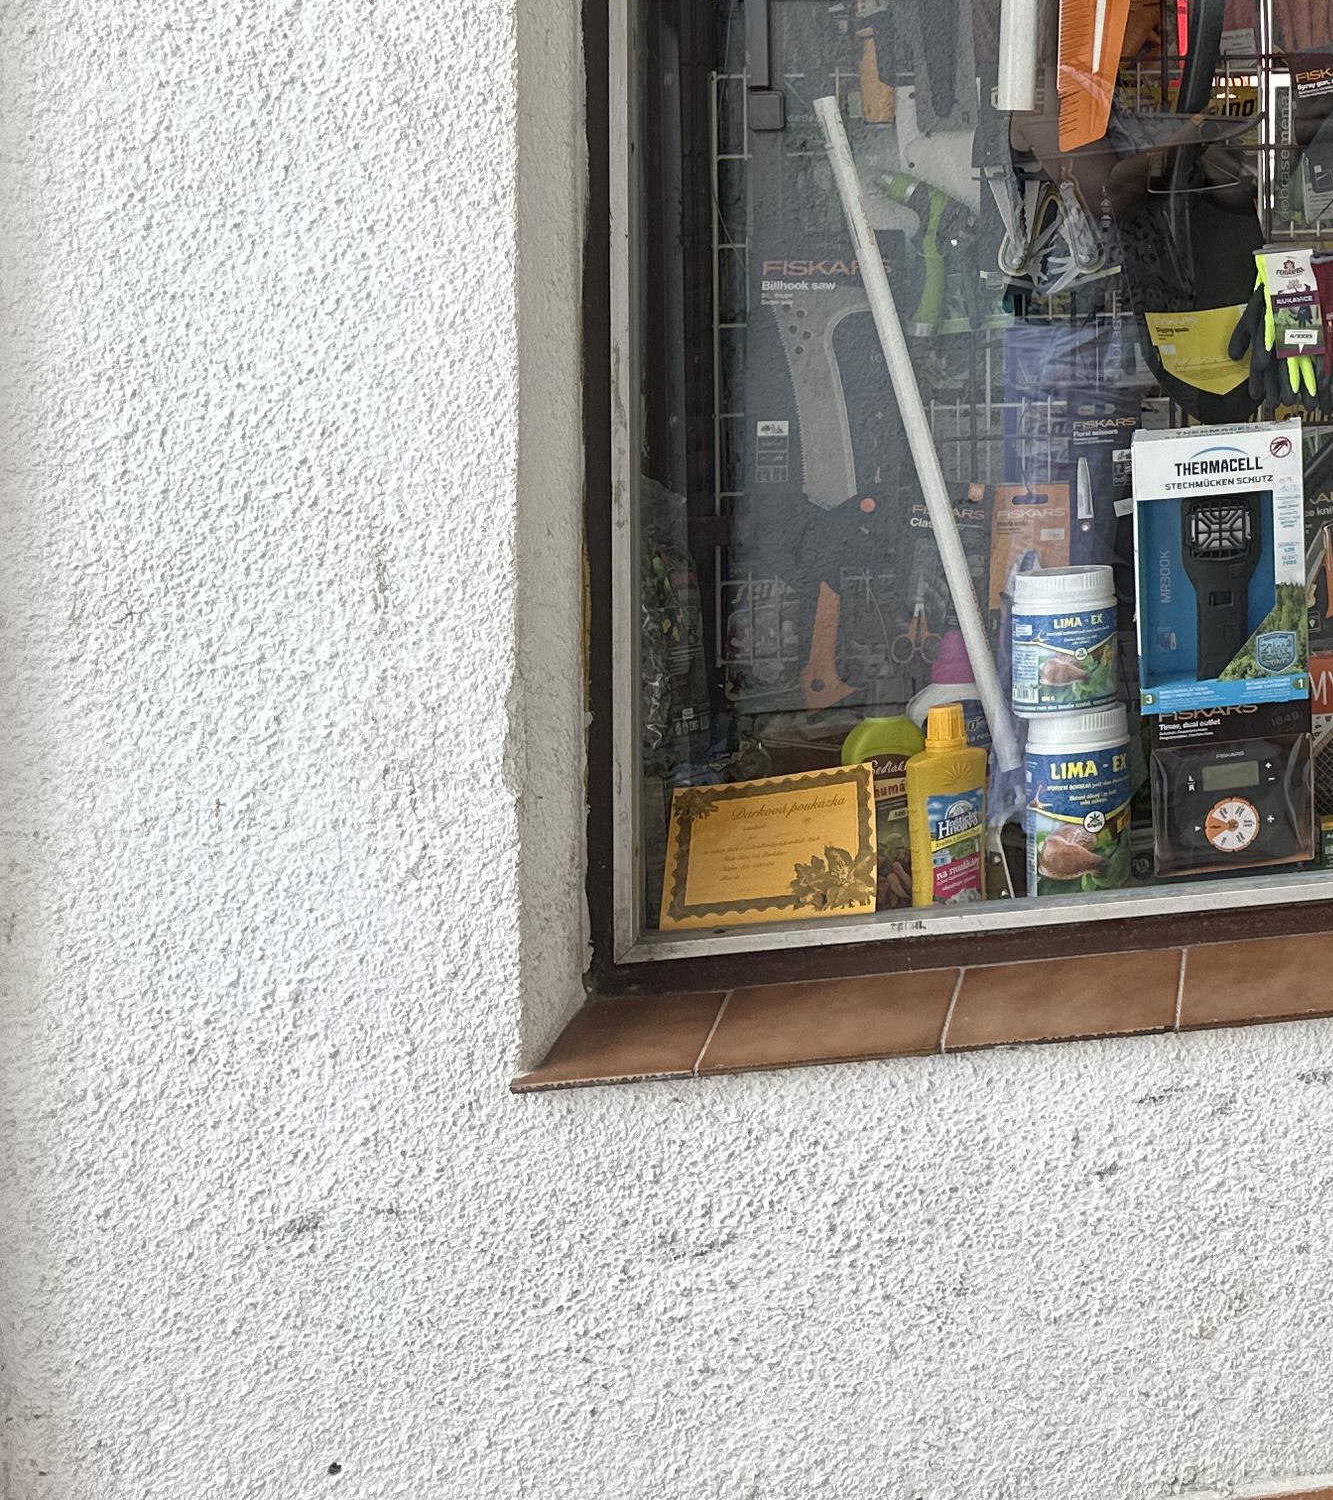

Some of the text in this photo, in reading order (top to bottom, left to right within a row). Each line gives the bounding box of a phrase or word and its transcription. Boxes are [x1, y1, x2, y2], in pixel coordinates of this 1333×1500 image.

[762, 260, 892, 276] FISKAS
[762, 280, 836, 291] Billhook saw
[1072, 417, 1136, 430] FISKARS
[1175, 457, 1263, 477] THERMACELL
[1165, 475, 1273, 491] STECHMÜCKEN SCHUTZ
[1161, 550, 1171, 604] MR300K
[1054, 614, 1103, 629] LIMA EX
[1298, 679, 1303, 688] 1
[1146, 694, 1153, 704] 3
[1051, 754, 1127, 779] LIMA EX
